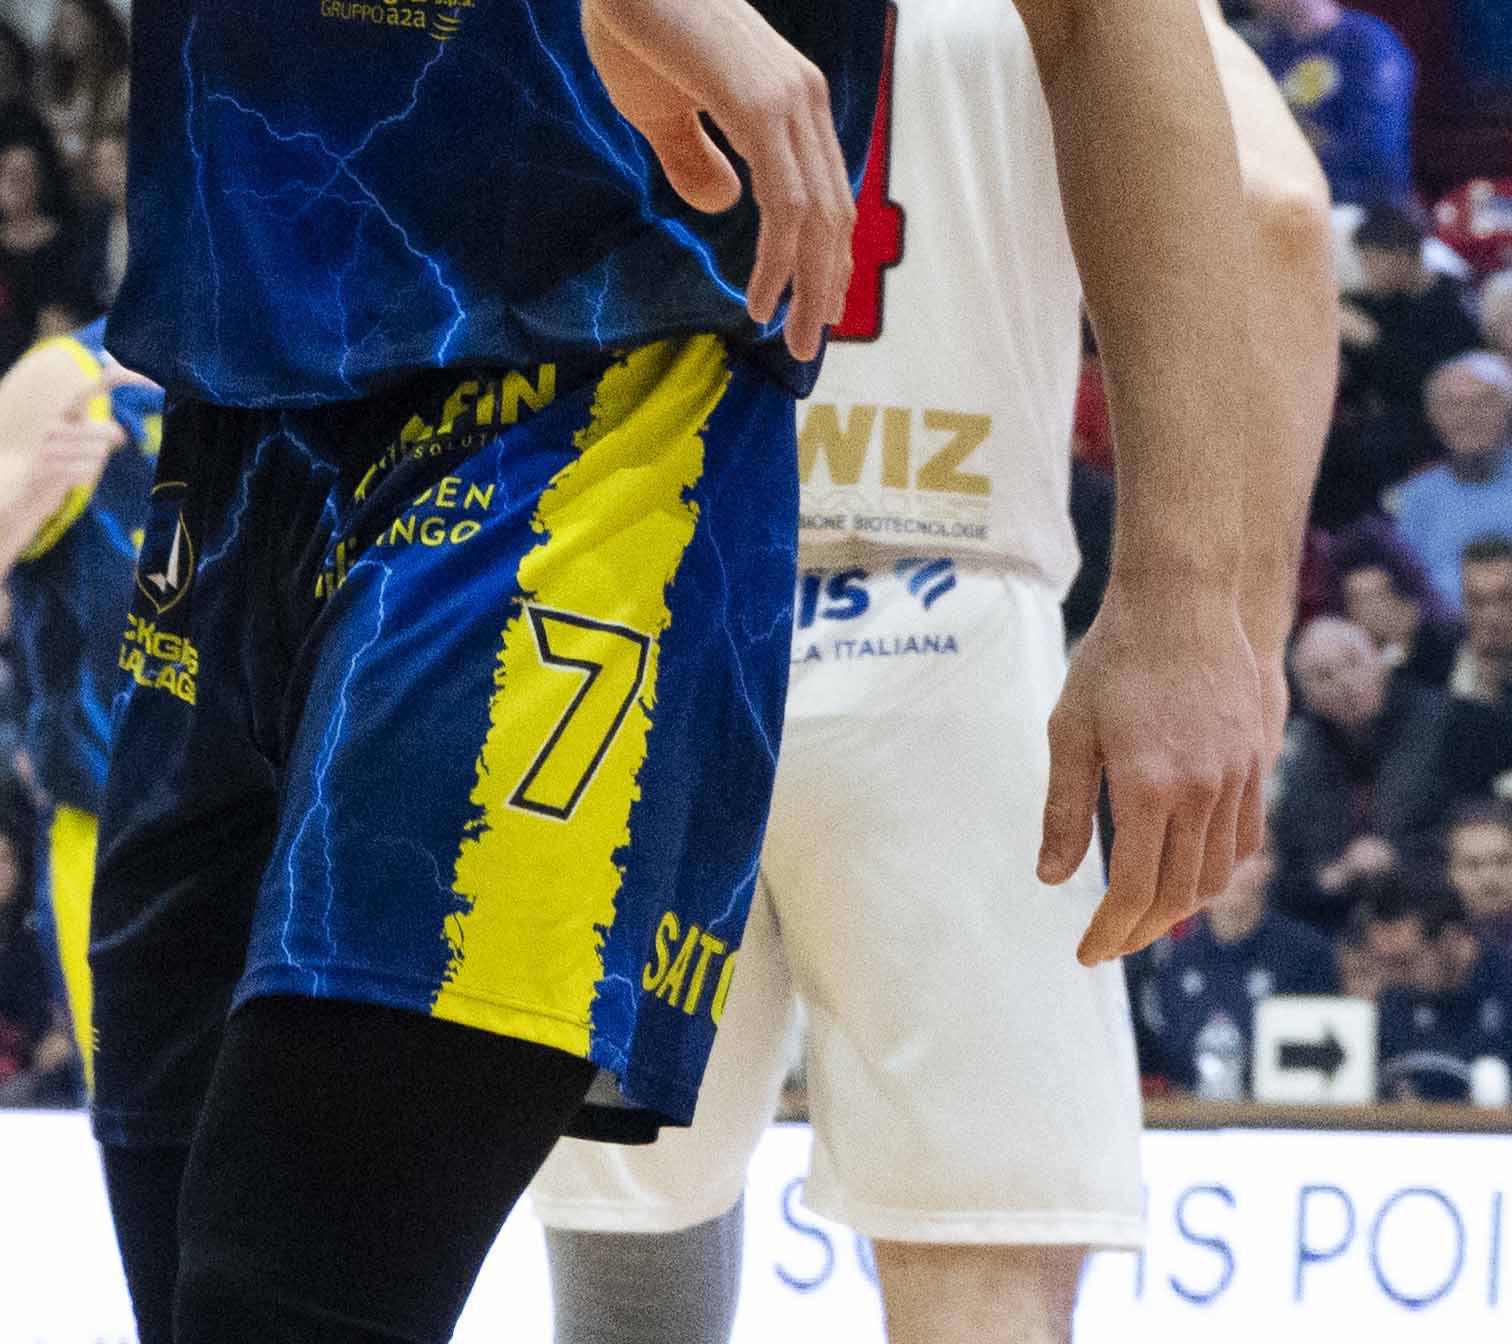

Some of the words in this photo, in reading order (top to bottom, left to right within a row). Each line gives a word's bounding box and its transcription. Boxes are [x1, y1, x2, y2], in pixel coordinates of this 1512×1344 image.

[320, 0, 385, 24] GRUPPO
[386, 6, 426, 29] a2a
[833, 633, 959, 659] ITALIANA
[507, 602, 653, 822] 7
